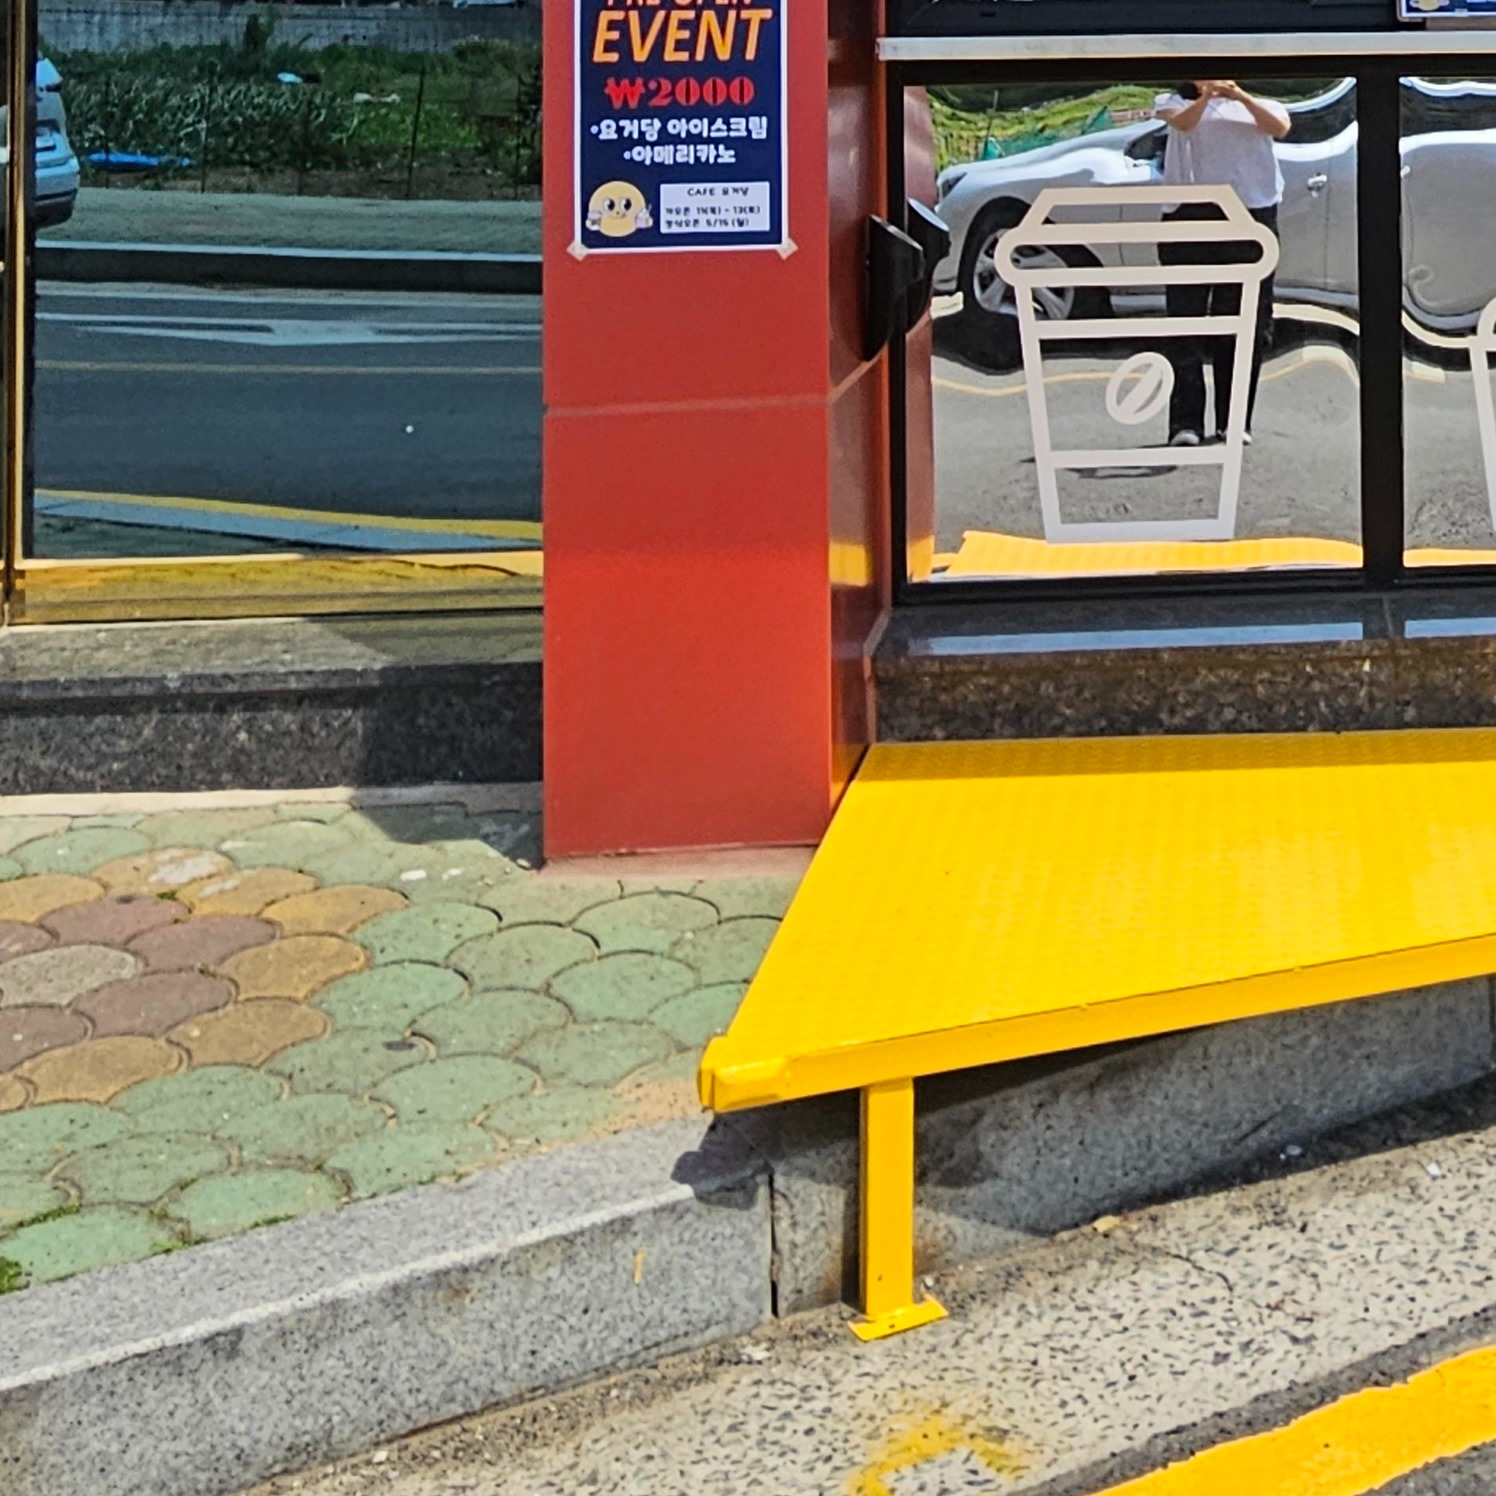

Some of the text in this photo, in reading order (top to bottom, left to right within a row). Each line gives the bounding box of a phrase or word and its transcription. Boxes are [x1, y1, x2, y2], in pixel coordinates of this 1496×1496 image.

[592, 9, 773, 63] EVENT
[604, 77, 755, 109] ₩2000
[666, 116, 767, 139] 아이스크림
